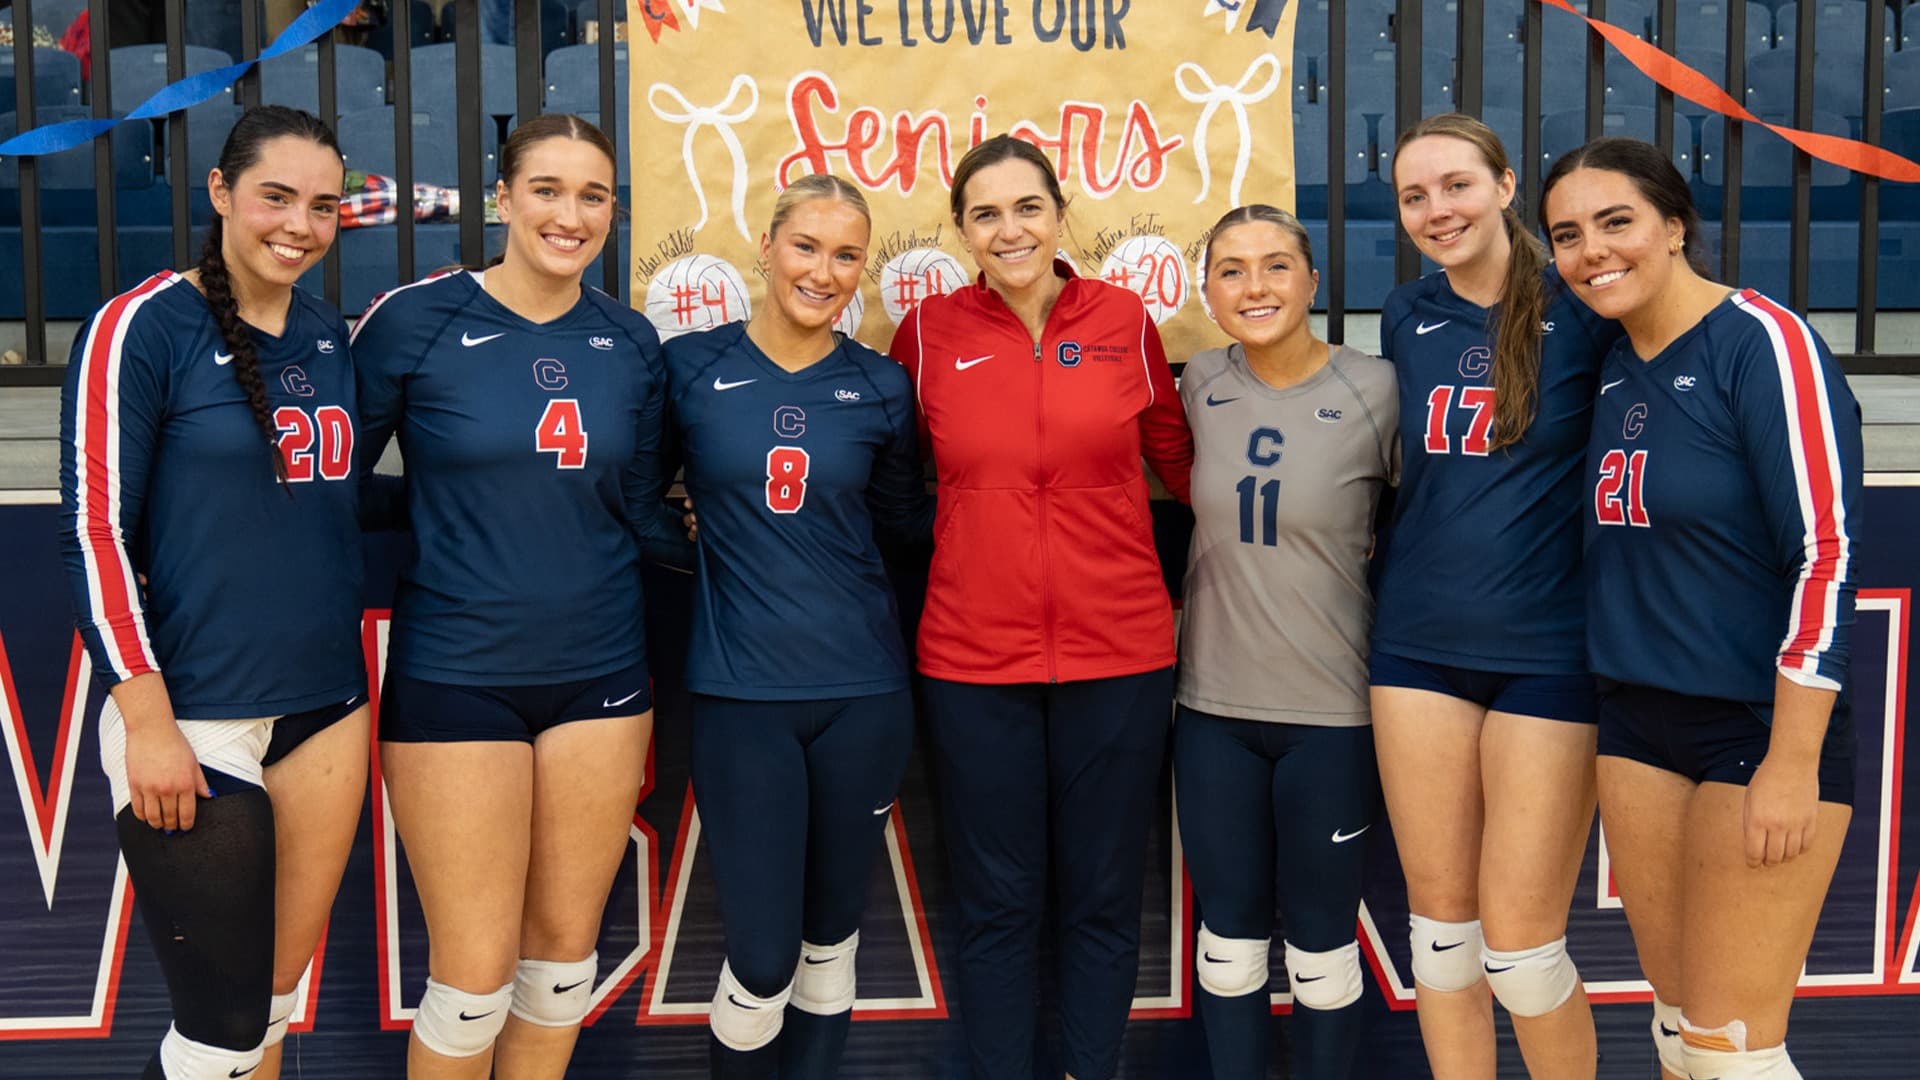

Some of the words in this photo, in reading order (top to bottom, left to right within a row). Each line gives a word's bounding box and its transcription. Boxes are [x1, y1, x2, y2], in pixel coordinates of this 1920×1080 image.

[801, 0, 882, 47] WE
[898, 0, 1012, 47] LOVE
[1032, 0, 1130, 52] OUR
[773, 69, 1185, 200] Senirs
[1081, 226, 1128, 274] Martina
[1130, 211, 1166, 237] Foster
[670, 279, 729, 326] #4
[592, 336, 614, 347] SAC
[1057, 341, 1082, 367] C
[1457, 346, 1491, 379] C
[280, 364, 316, 397] C
[532, 357, 569, 391] C
[838, 389, 861, 400] SAC
[1676, 375, 1696, 388] SAC
[534, 398, 589, 470] 4
[773, 405, 806, 439] C
[1317, 408, 1343, 420] SAC
[1423, 384, 1497, 457] 17
[1622, 402, 1649, 440] C
[272, 404, 355, 484] 20
[1246, 426, 1285, 468] C
[765, 445, 810, 514] 8
[1594, 448, 1652, 528] 21
[1235, 474, 1281, 547] 11
